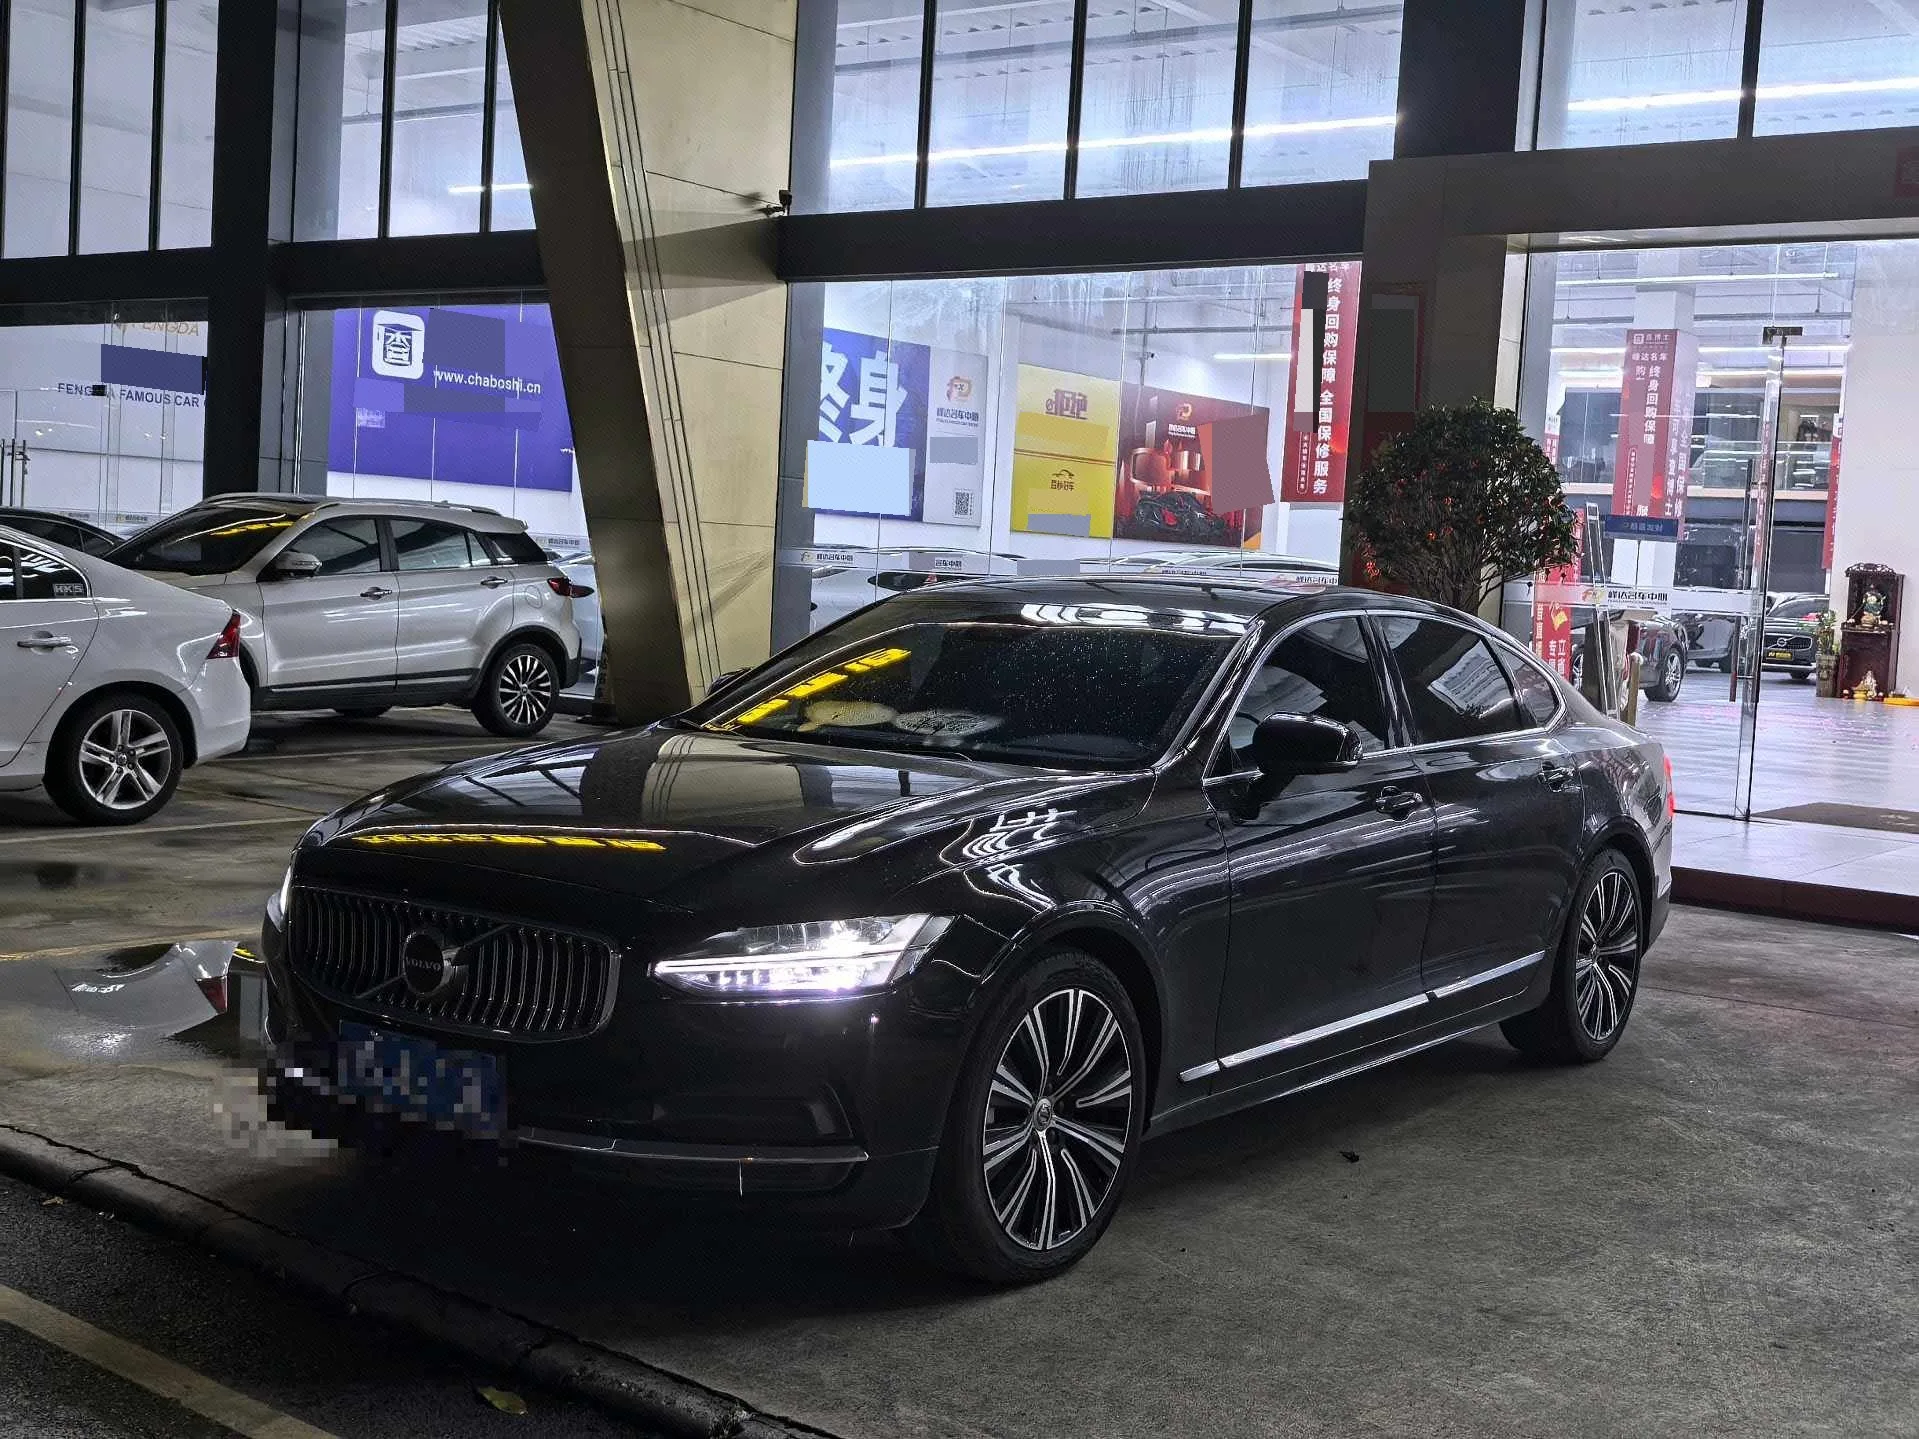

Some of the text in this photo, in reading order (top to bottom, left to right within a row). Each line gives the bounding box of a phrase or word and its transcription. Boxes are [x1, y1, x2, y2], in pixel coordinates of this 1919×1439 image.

[432, 368, 541, 394] www.chaboshi.cn
[1312, 277, 1343, 495] 终身回购保障 全国保修服务
[120, 389, 171, 405] FAMOUS
[174, 395, 199, 408] CAR
